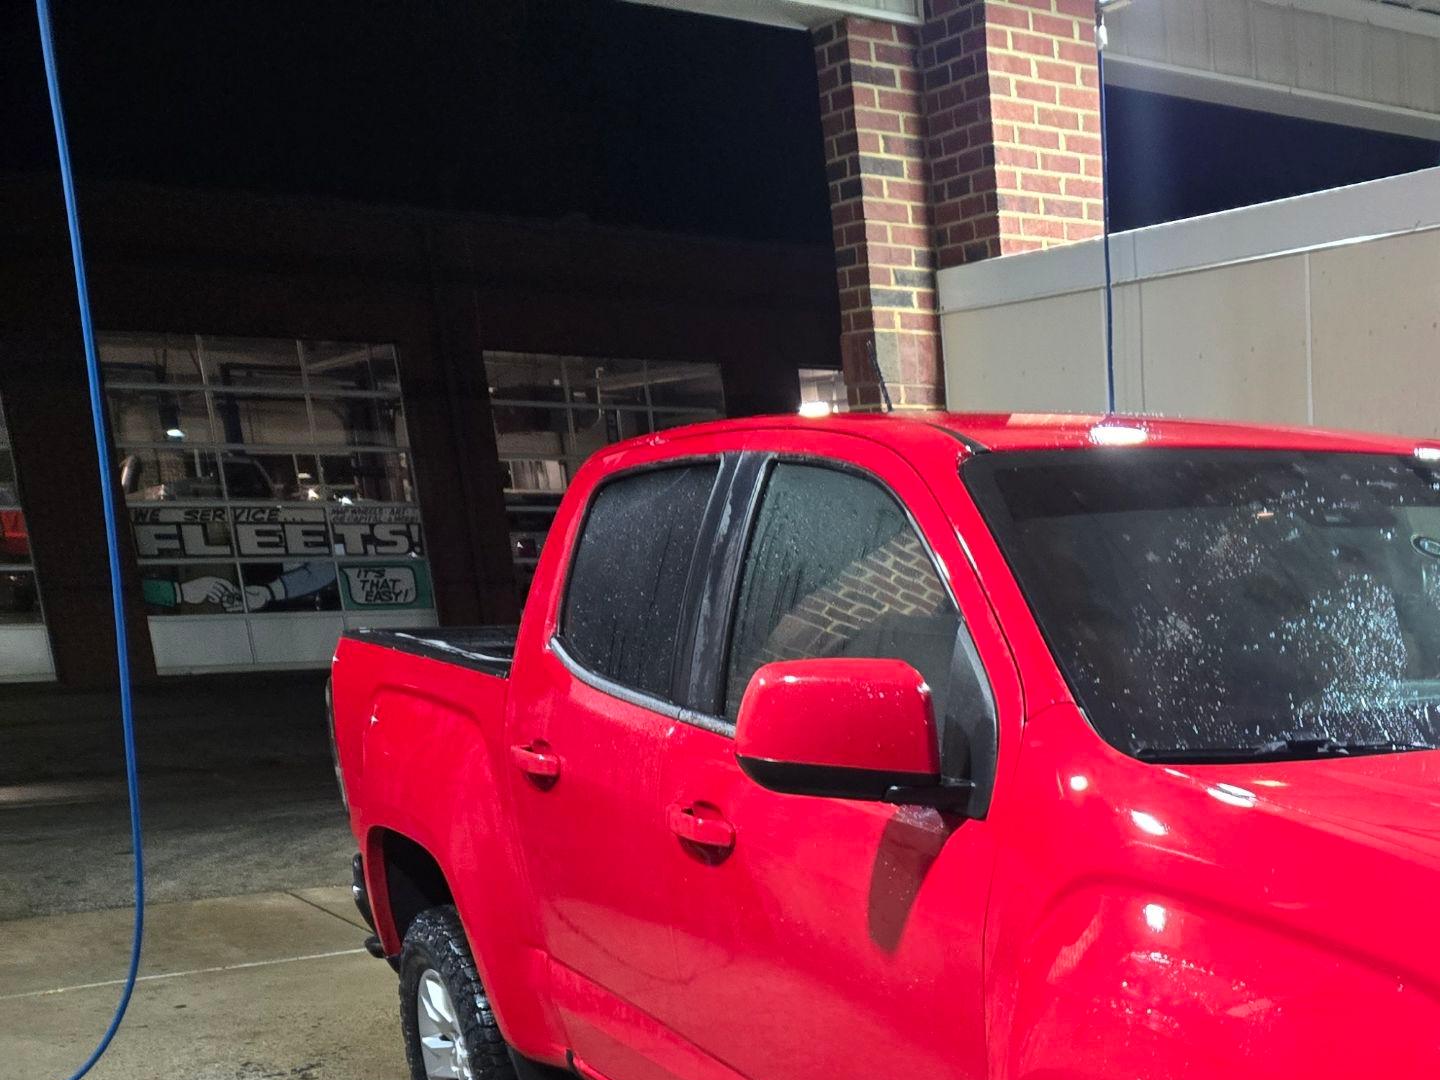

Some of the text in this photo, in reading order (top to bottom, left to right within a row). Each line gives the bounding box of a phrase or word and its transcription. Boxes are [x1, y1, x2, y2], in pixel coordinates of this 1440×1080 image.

[134, 508, 161, 522] WE
[359, 579, 401, 591] THAT
[365, 589, 409, 602] EASY!
